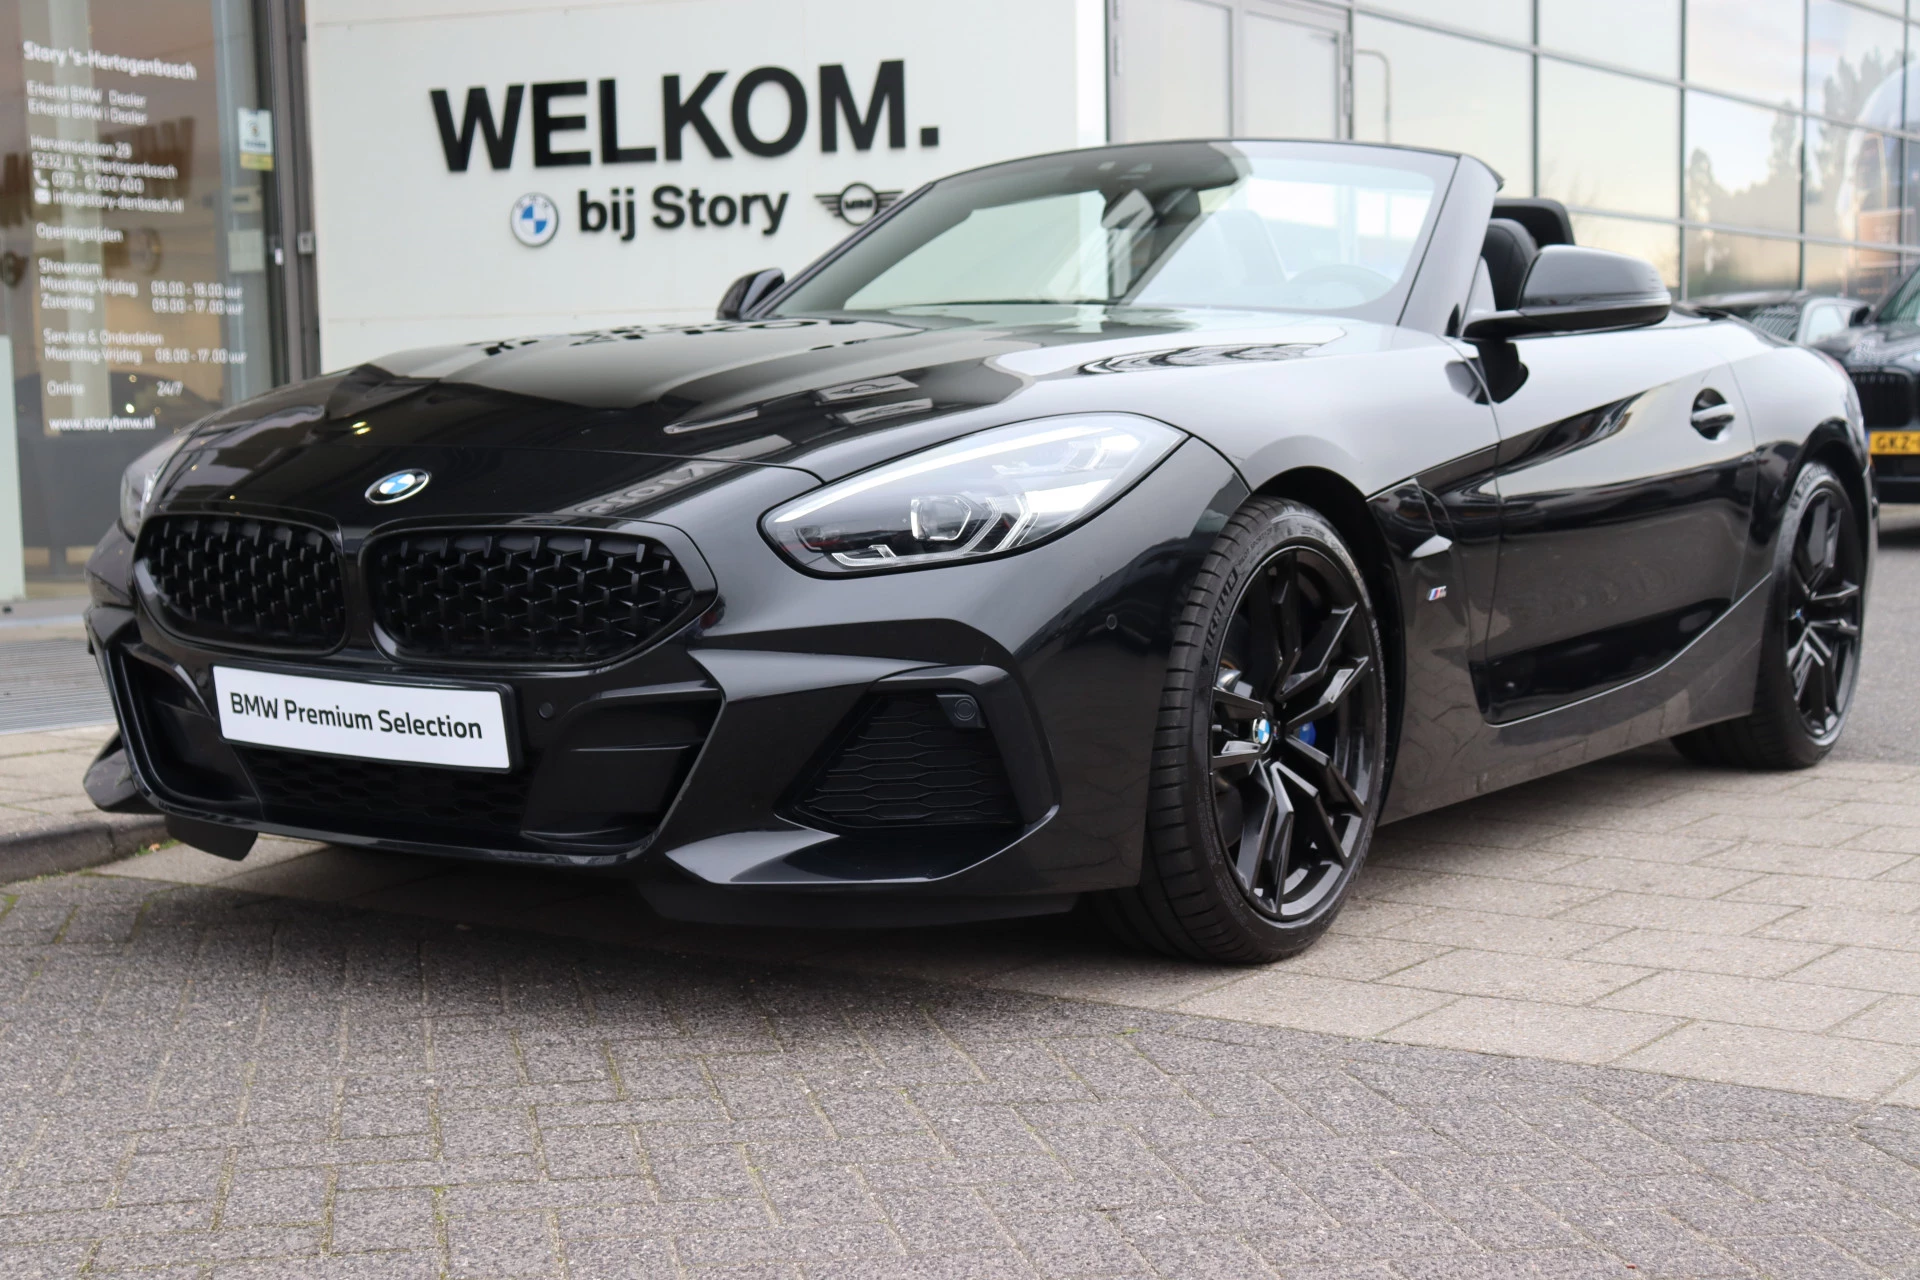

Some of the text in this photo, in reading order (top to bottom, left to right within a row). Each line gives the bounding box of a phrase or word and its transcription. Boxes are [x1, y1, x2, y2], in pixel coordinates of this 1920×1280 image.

[24, 40, 197, 80] Story 's-Hertogenbosch
[26, 80, 146, 108] Erkend BMW Dealer
[28, 98, 70, 118] Erkend
[72, 103, 103, 121] BMW
[110, 108, 148, 126] Dealer
[429, 59, 939, 173] WELKOM.
[115, 142, 132, 159] 29
[32, 151, 62, 170] 5232
[78, 157, 178, 180] 's-Hertogenbosch
[52, 170, 76, 188] 073
[84, 174, 93, 190] 6
[95, 175, 119, 192] 200
[120, 176, 144, 194] 400
[578, 185, 790, 242] bij Story
[36, 222, 124, 244] Openingstijden
[38, 257, 102, 276] Showroom
[40, 276, 138, 298] Maandag-Vrijdag
[150, 280, 185, 296] 09.00
[193, 282, 224, 298] 18.00
[224, 286, 243, 298] uur
[40, 293, 95, 313] Zaterdag
[152, 297, 186, 314] 09.00
[194, 299, 225, 314] 17.00
[226, 303, 244, 315] uur
[43, 327, 164, 346] Service & Onderdelen
[44, 346, 142, 366] Maandag-Vrijdag
[154, 348, 188, 364] 08.00
[197, 348, 228, 364] 17.00
[228, 352, 248, 364] uur
[46, 380, 184, 397] Online 24/7
[48, 414, 156, 432] www.storybmw.nl
[1876, 434, 1920, 450] GKZ-
[230, 692, 483, 740] BMW Premium Selection
